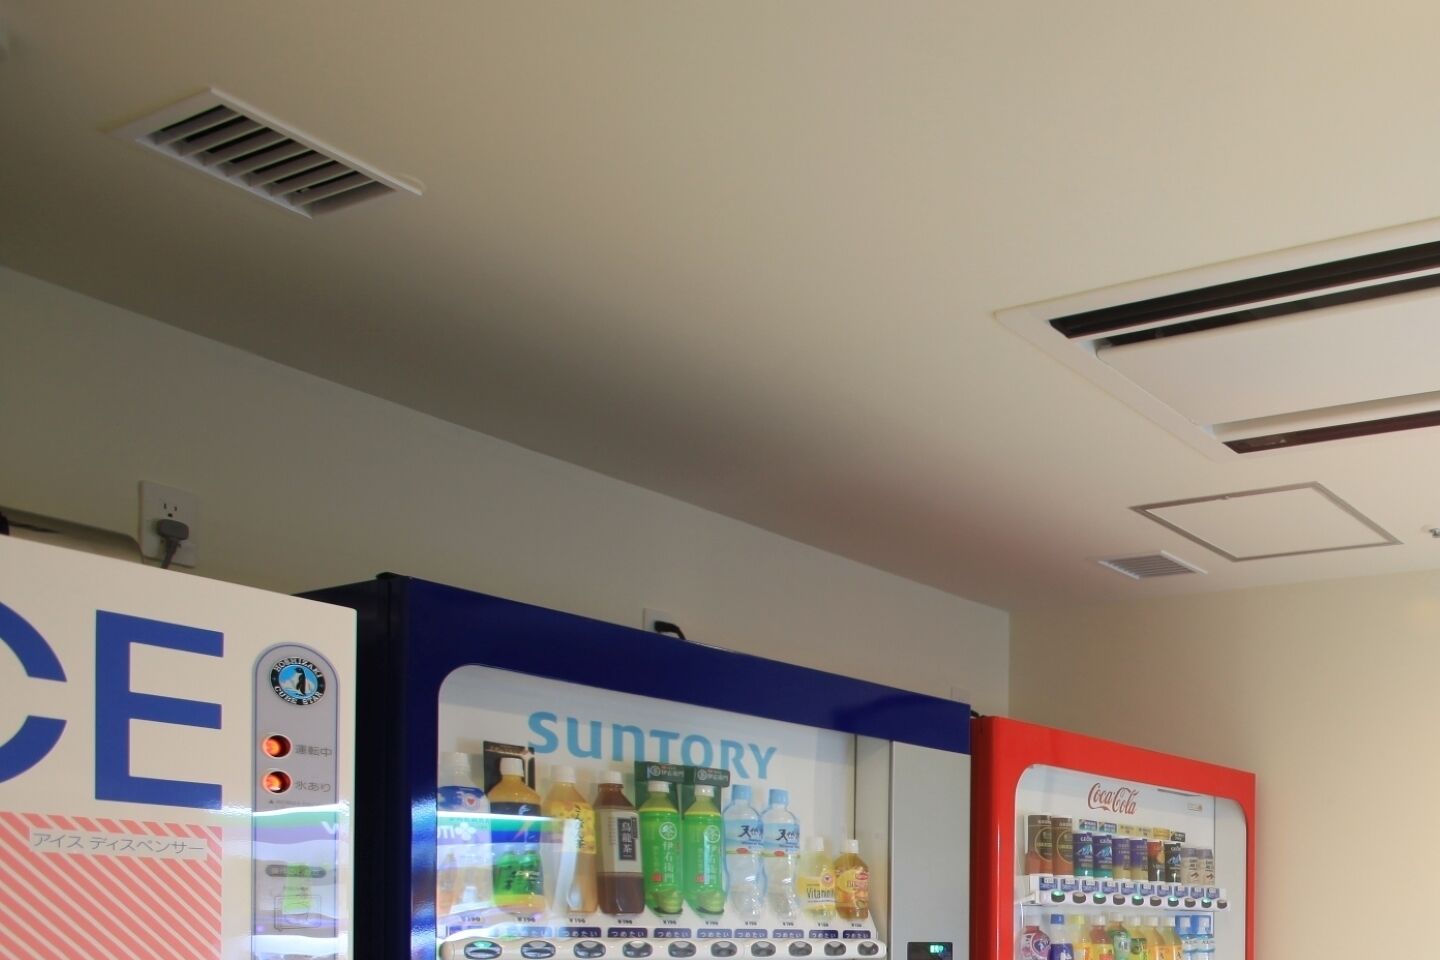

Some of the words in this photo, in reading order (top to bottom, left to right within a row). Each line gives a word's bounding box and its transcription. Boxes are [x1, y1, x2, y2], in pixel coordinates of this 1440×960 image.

[1087, 783, 1139, 815] Coca-Cola
[32, 833, 85, 850] アイス
[89, 836, 205, 855] ディスペンサー
[610, 930, 645, 939] つめたい
